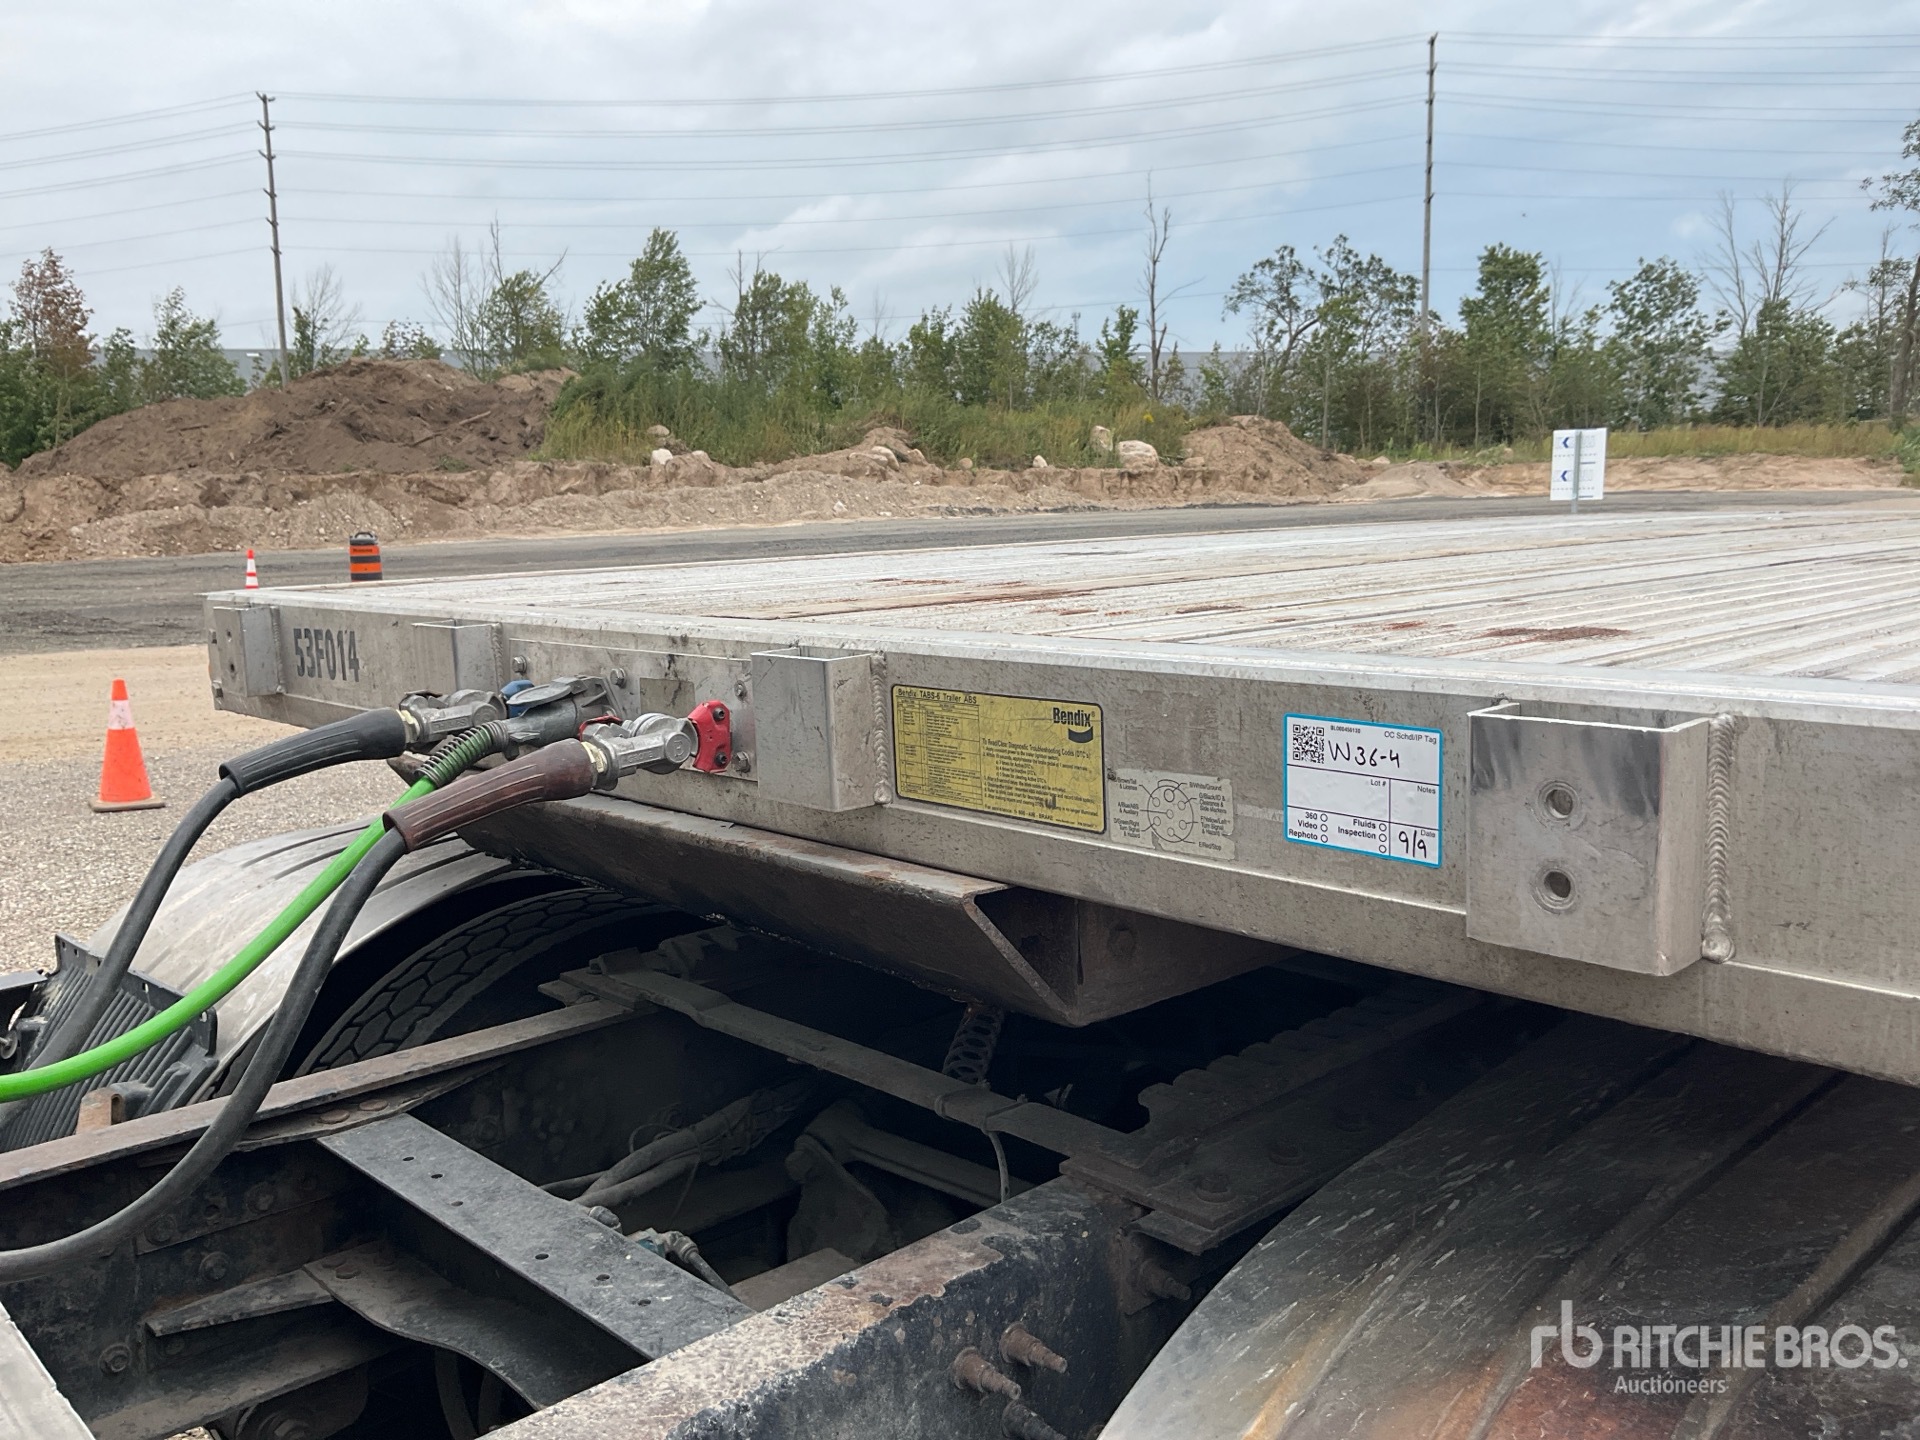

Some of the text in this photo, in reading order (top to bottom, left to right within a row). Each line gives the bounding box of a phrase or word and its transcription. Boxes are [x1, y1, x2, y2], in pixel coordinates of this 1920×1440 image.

[293, 628, 360, 682] 53F014
[919, 690, 940, 700] TABS-6
[943, 692, 961, 702] Trailer
[963, 695, 977, 704] ABS
[1053, 707, 1091, 727] Bendix
[1424, 736, 1437, 745] Tag
[1370, 779, 1381, 787] Lot
[1417, 785, 1436, 794] Notes
[1305, 812, 1318, 820] 360
[1298, 820, 1318, 829] Video
[1353, 819, 1376, 829] Fluids
[1288, 828, 1318, 841] Rephoto
[1337, 827, 1376, 840] Inspection
[1420, 829, 1436, 838] Date
